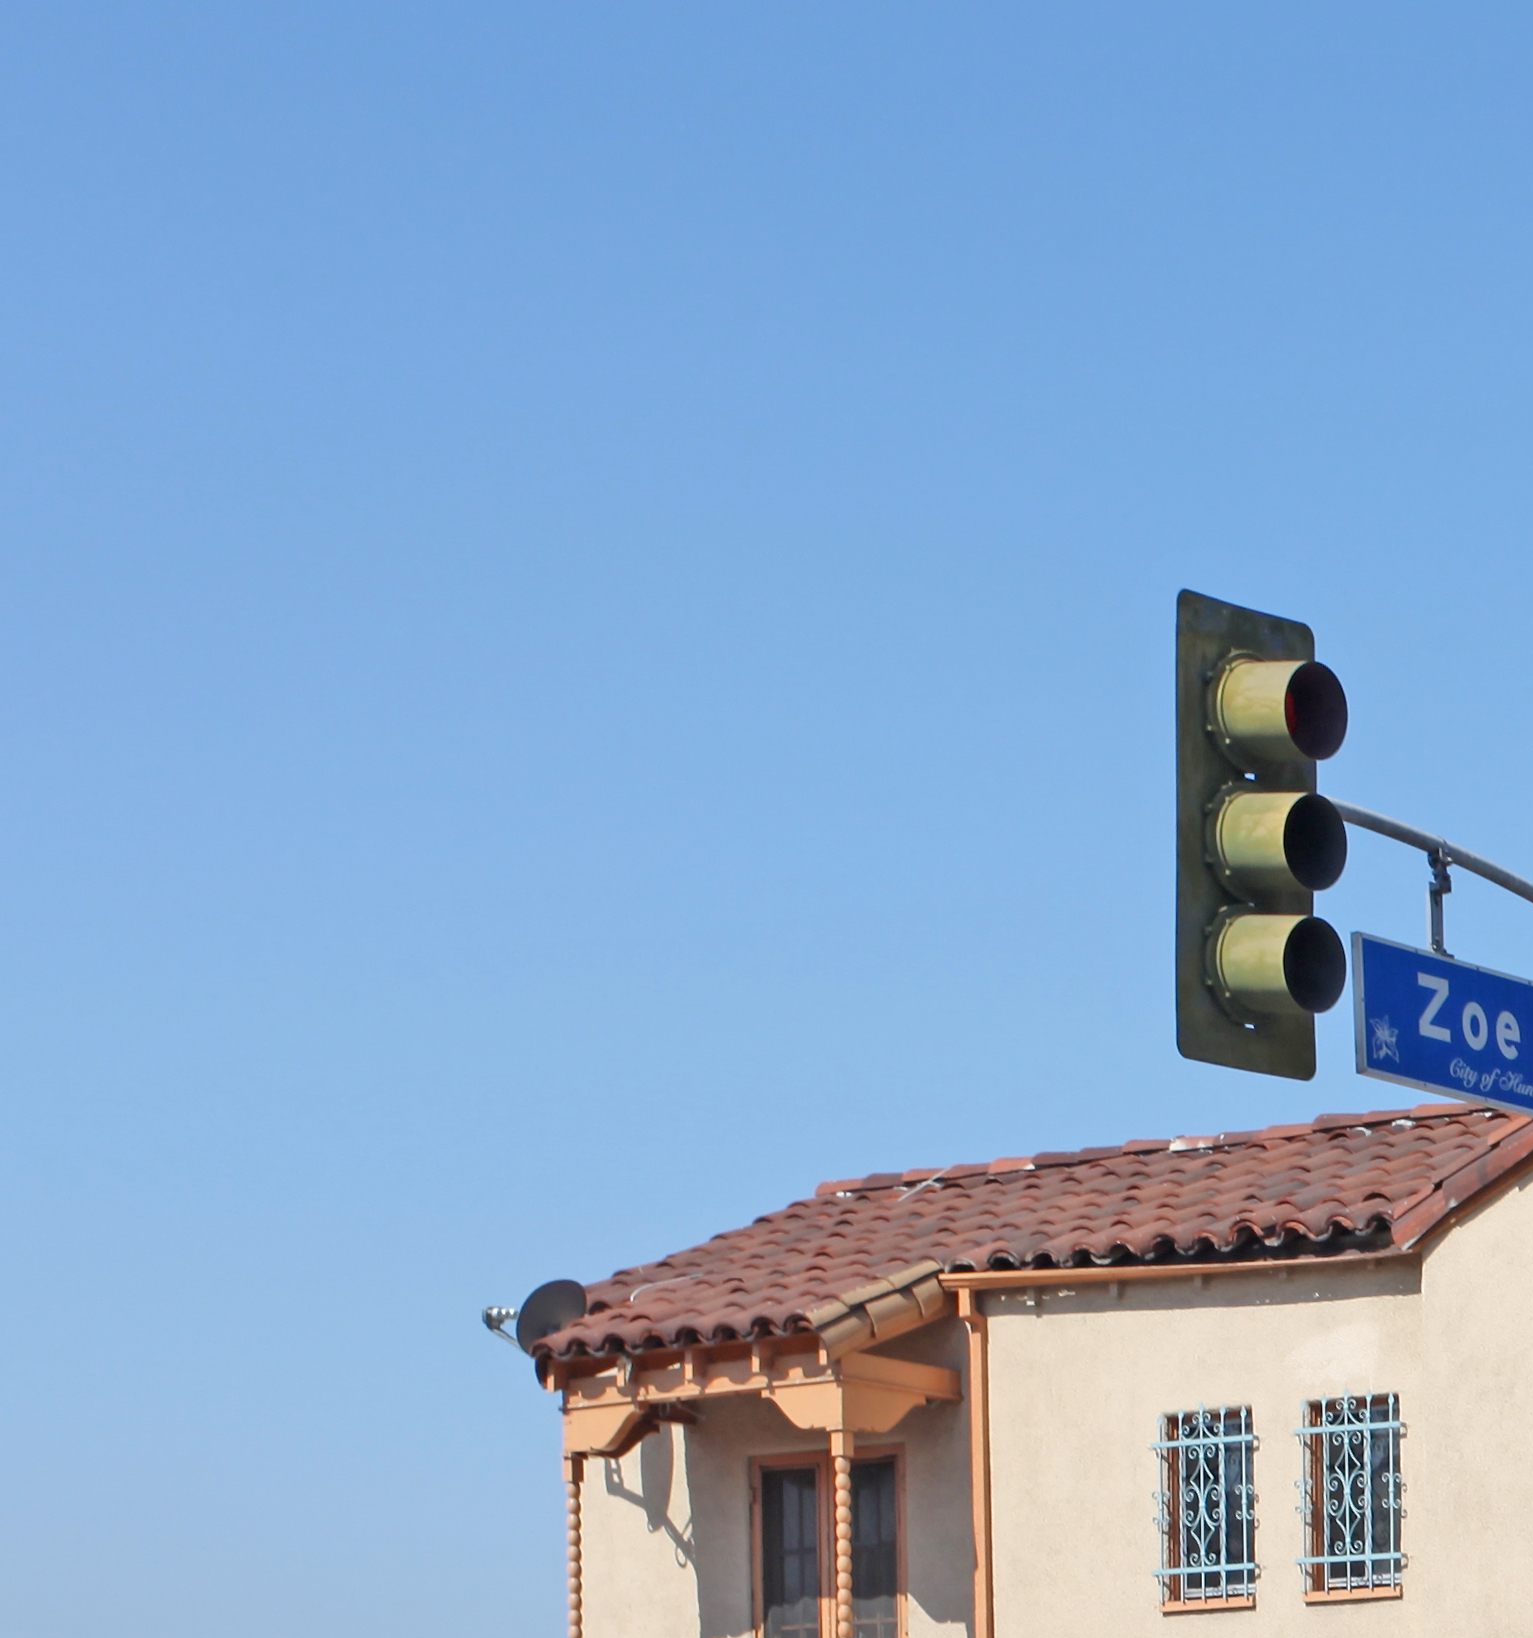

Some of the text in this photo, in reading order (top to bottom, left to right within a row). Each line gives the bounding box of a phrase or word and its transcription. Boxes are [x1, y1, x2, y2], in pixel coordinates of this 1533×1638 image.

[1417, 971, 1521, 1060] Zoe
[1449, 1057, 1478, 1088] City
[1480, 1068, 1500, 1091] of
